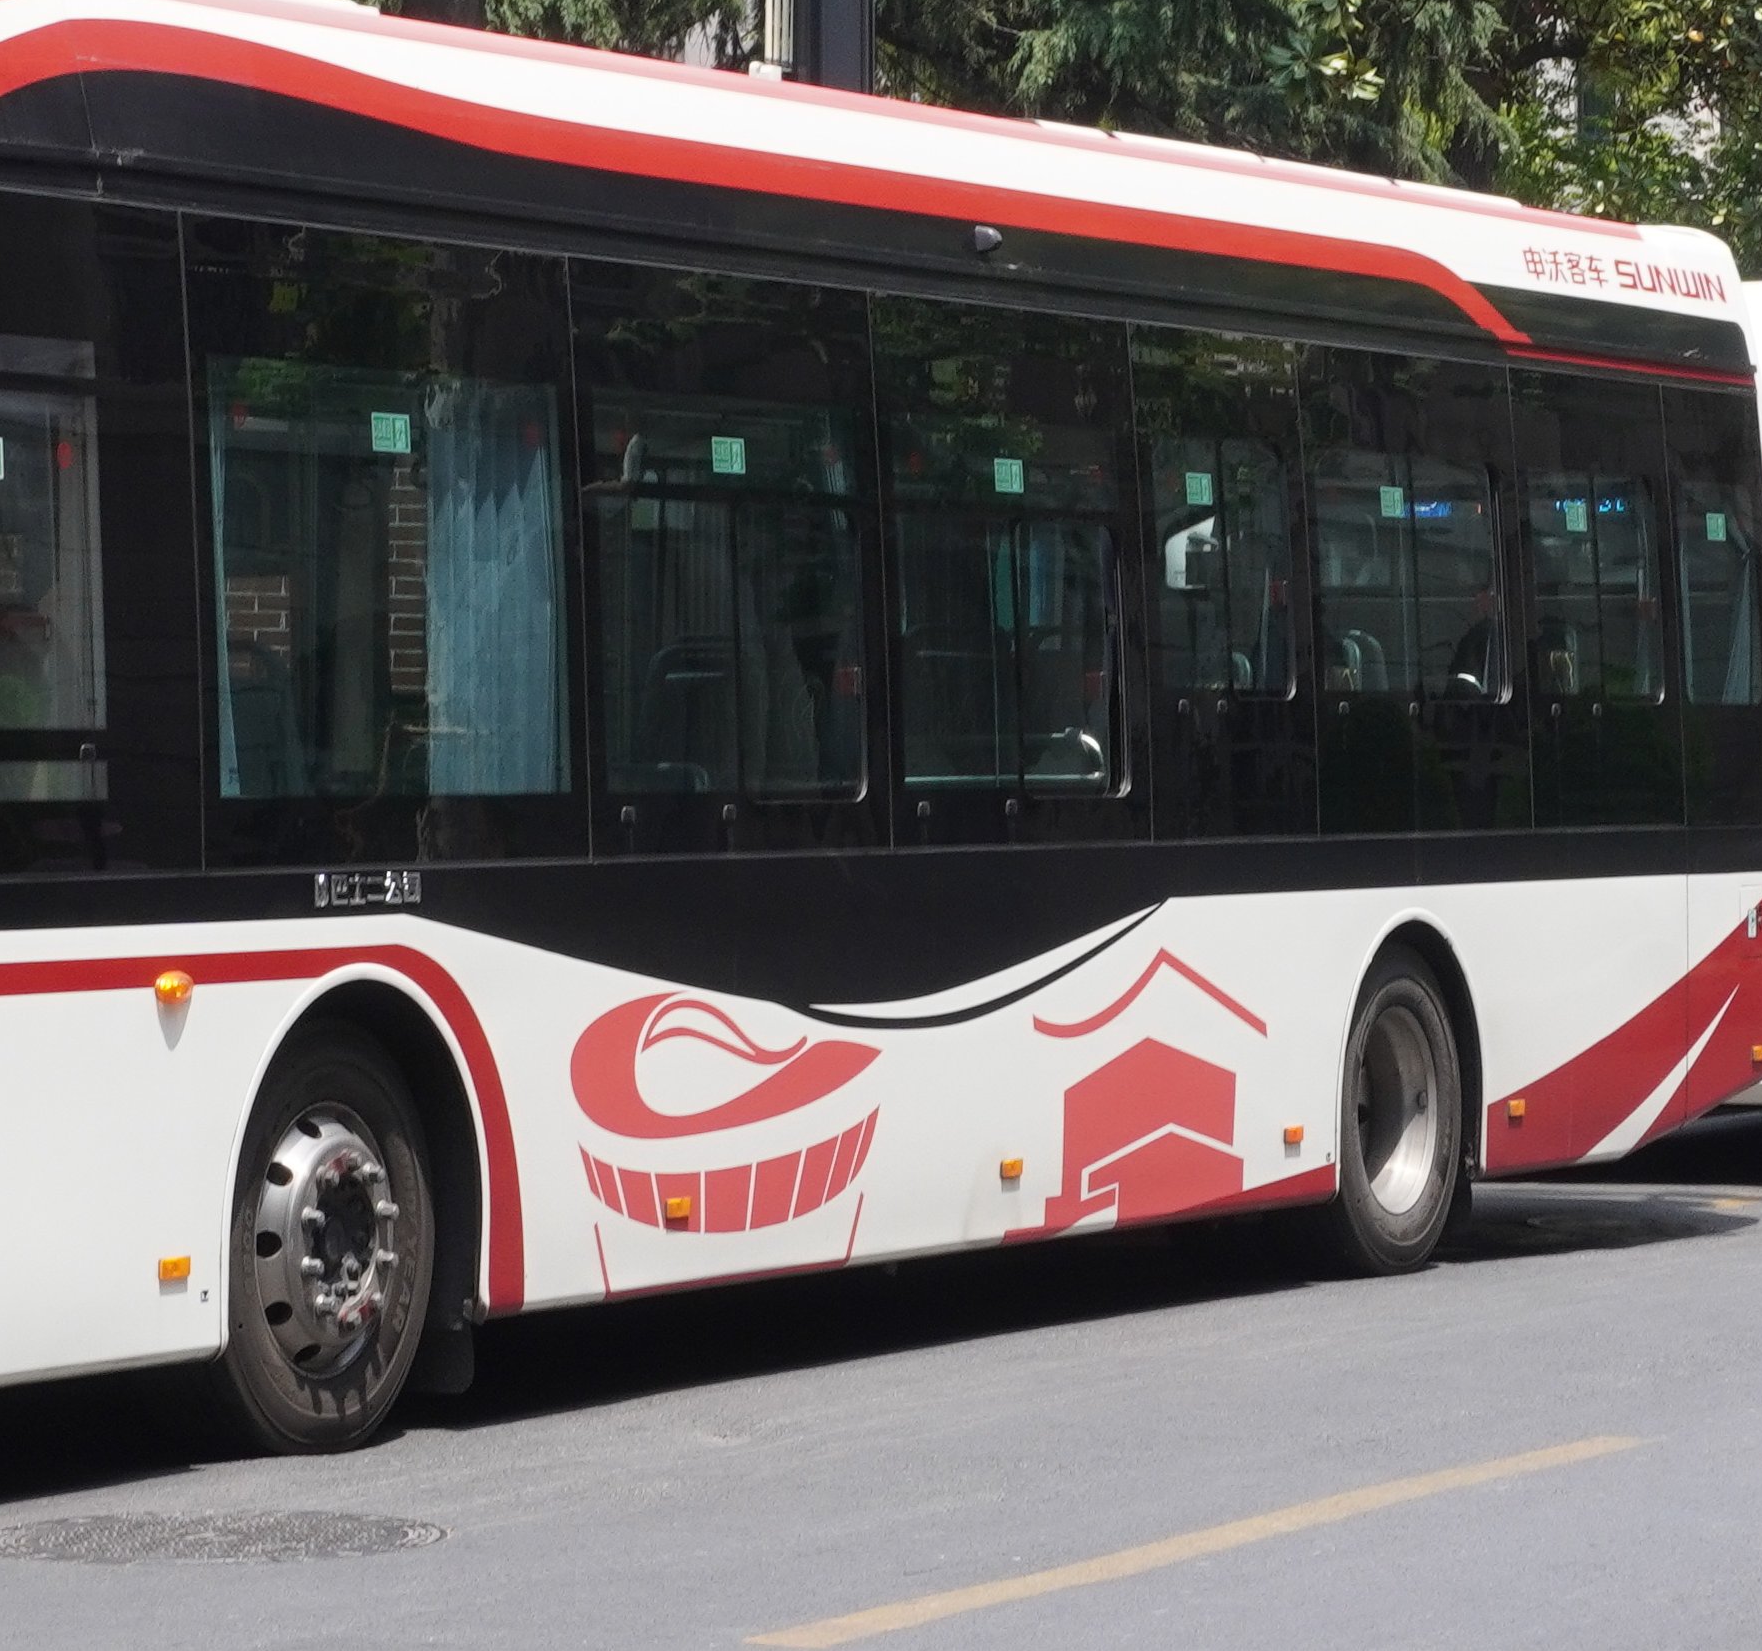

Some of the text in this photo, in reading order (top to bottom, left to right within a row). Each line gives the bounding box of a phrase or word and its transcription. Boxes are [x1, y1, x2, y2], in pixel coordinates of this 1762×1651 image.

[1522, 246, 1728, 304] 申沃客车 SUNWIN
